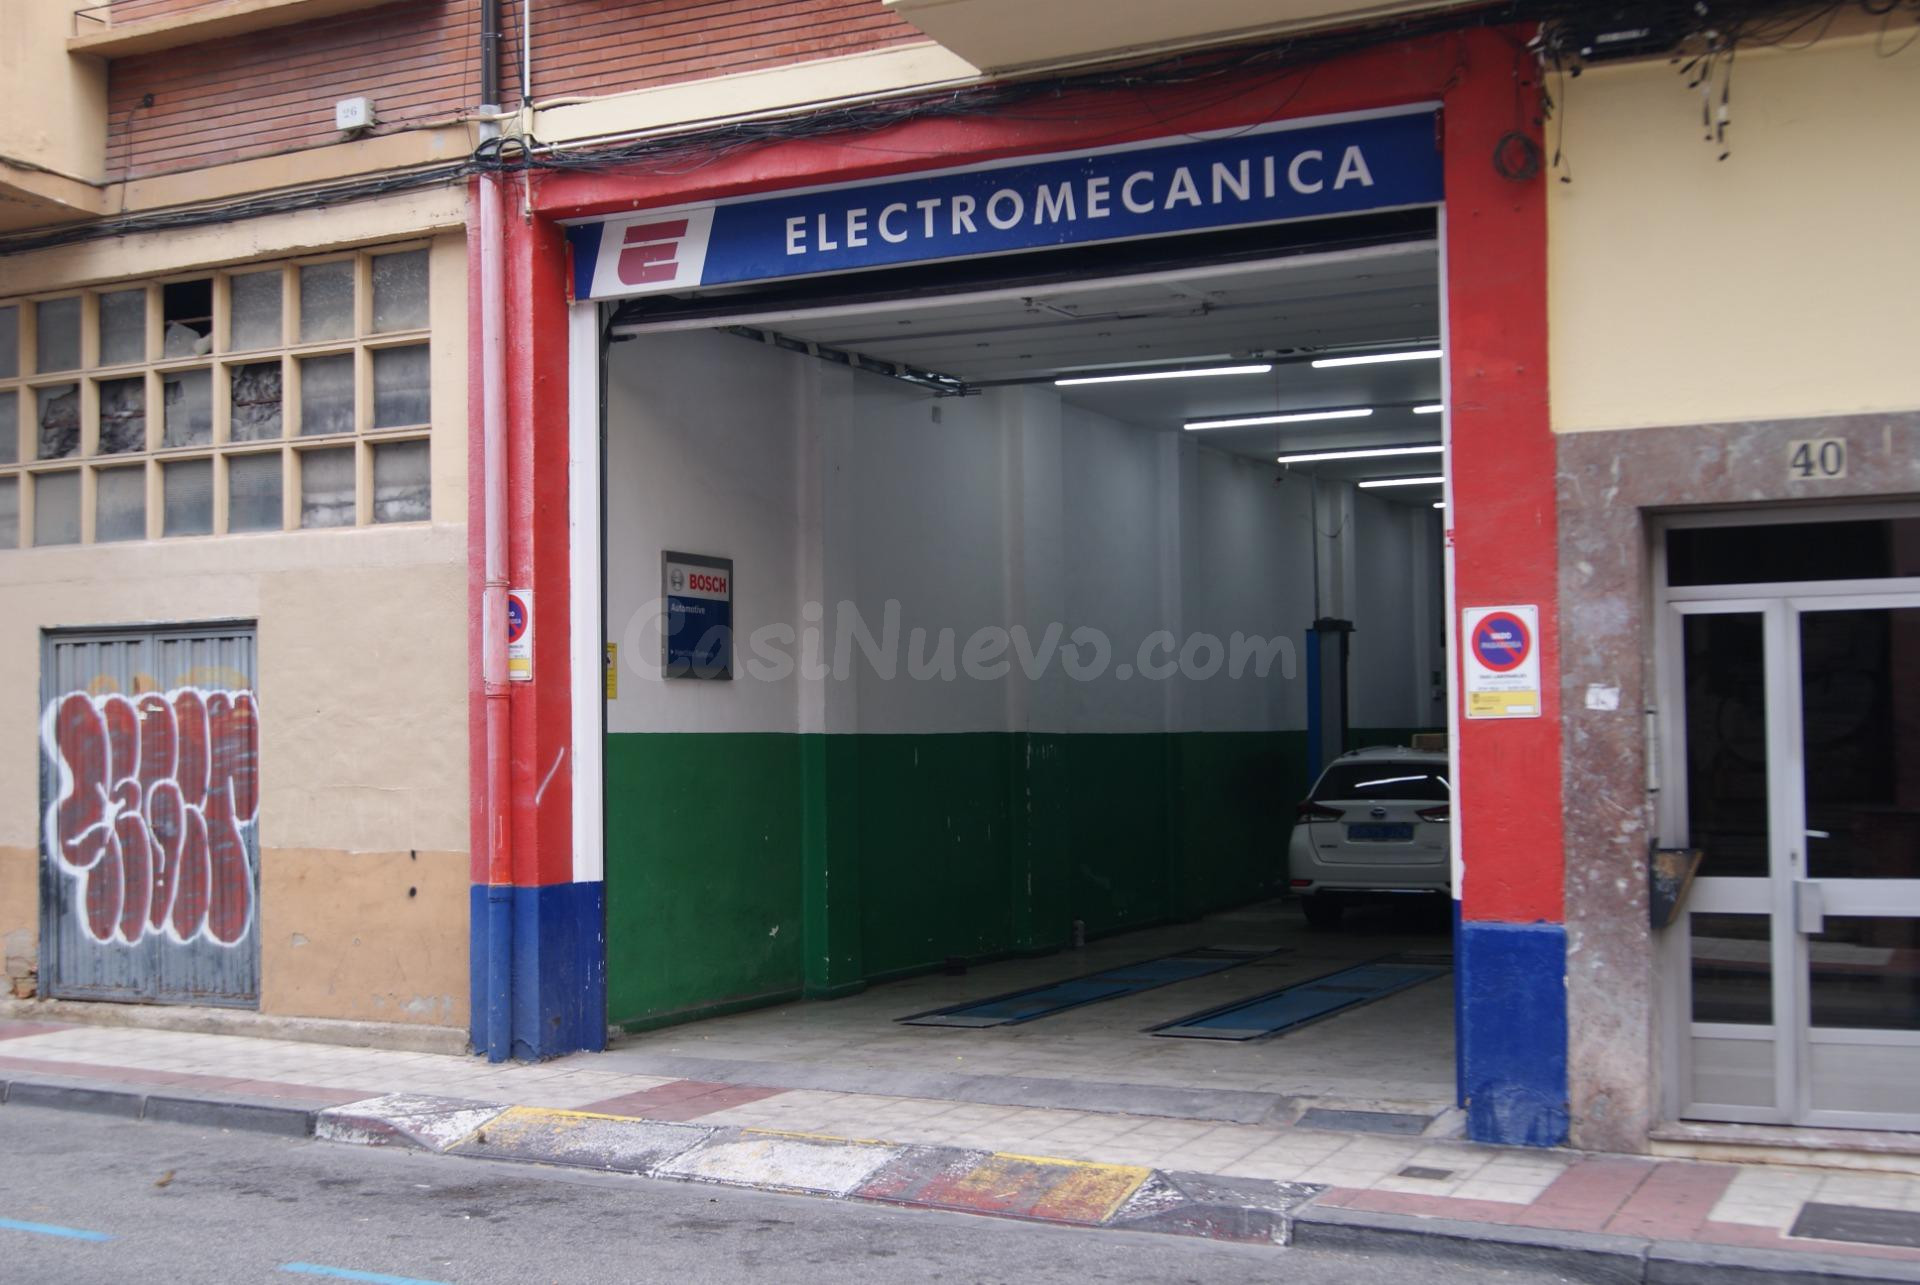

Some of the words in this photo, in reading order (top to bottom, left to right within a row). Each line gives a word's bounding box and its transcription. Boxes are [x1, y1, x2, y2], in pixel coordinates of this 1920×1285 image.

[786, 145, 1374, 256] ELECTROMECANICA
[1791, 440, 1843, 477] 40
[689, 573, 727, 593] BOSCH
[670, 602, 706, 615] Automotive
